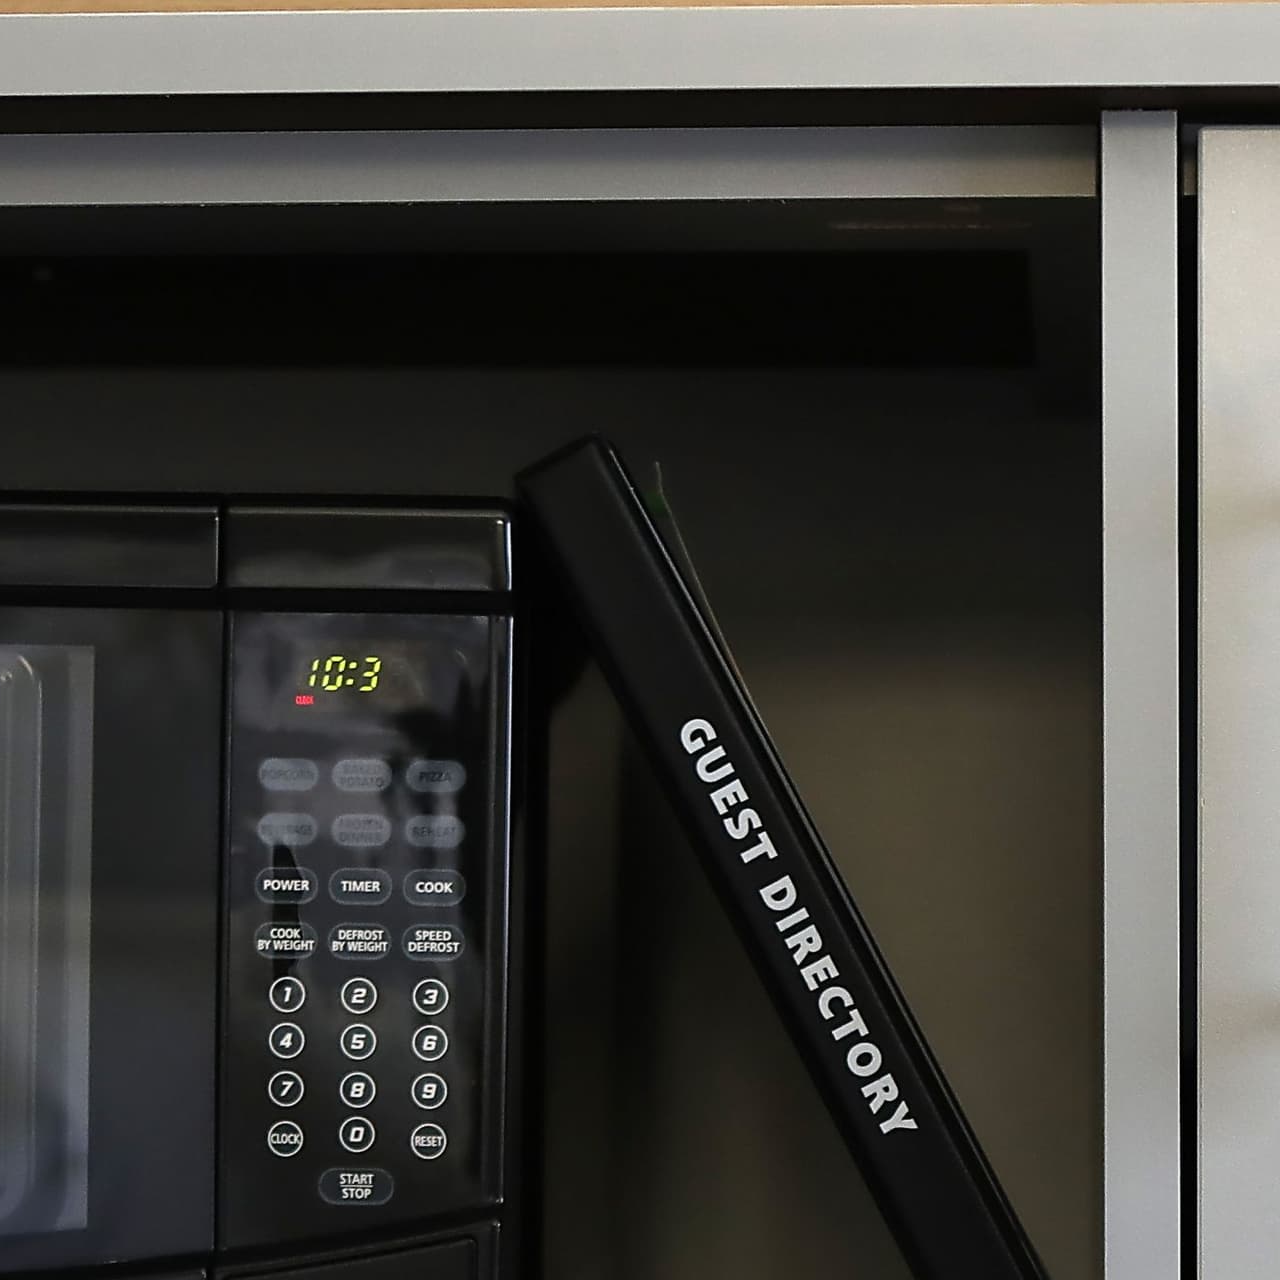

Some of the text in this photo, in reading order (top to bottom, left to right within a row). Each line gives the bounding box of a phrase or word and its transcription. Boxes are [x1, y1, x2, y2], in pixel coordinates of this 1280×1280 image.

[419, 771, 452, 783] PIZZA
[263, 879, 310, 891] POWER
[340, 880, 381, 893] TIMER
[415, 881, 453, 894] COOK
[680, 718, 918, 1133] GUEST DIRECTORY
[269, 927, 301, 939] COOK
[338, 929, 384, 941] DEFROST
[415, 930, 452, 941] SPEED
[257, 939, 315, 951] BY WEIGHT
[331, 940, 388, 952] BY WEIGHT
[407, 941, 461, 953] DEFROST
[284, 986, 292, 1003] 1
[351, 987, 367, 1004] 2
[422, 988, 439, 1005] 3
[279, 1032, 293, 1049] 4
[350, 1033, 367, 1050] 5
[422, 1034, 438, 1051] 6
[280, 1080, 294, 1097] 7
[350, 1082, 366, 1098] 8
[421, 1083, 437, 1099] 9
[271, 1133, 300, 1145] CLOCK
[349, 1126, 365, 1143] 0
[415, 1135, 442, 1147] RESET
[339, 1173, 374, 1184] START
[341, 1188, 372, 1200] STOP
